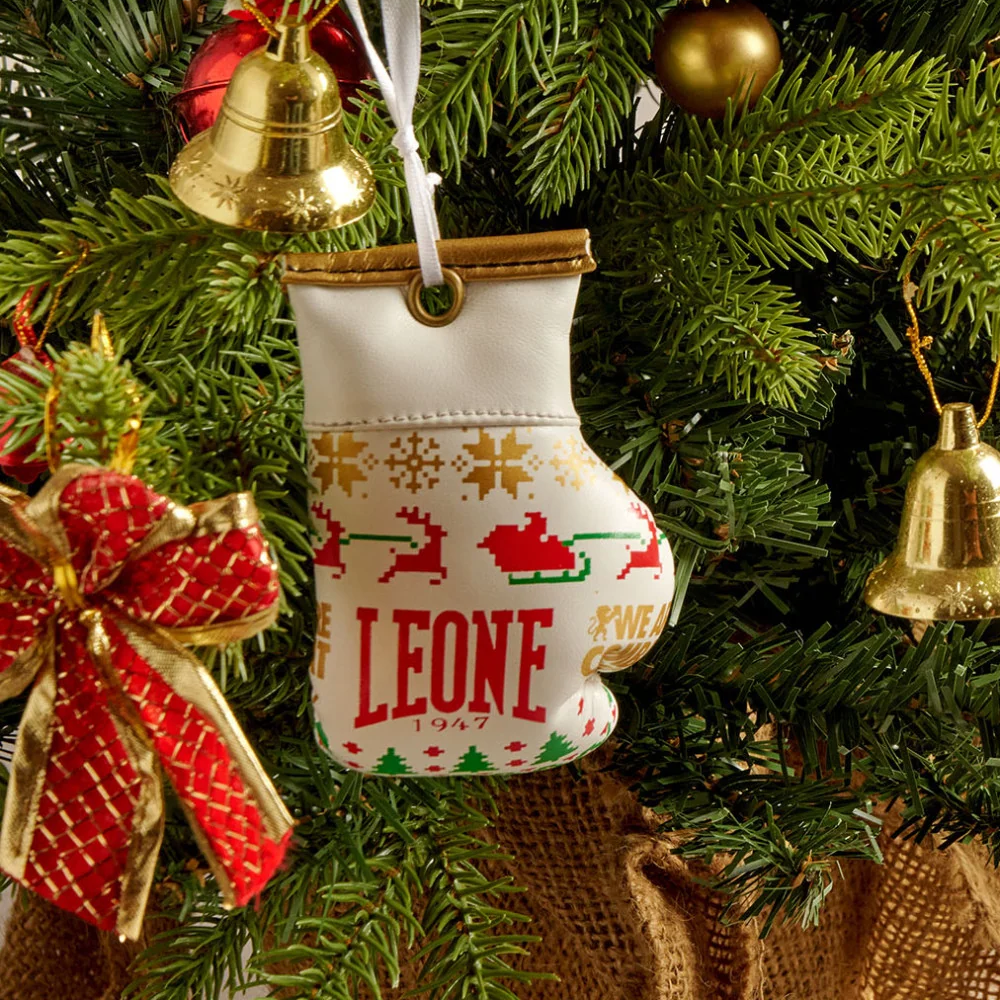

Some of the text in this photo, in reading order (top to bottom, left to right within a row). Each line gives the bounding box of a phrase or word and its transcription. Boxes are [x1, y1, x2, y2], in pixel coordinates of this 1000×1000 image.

[613, 604, 654, 640] WE
[354, 607, 554, 729] LEONE
[411, 716, 490, 732] 1947
